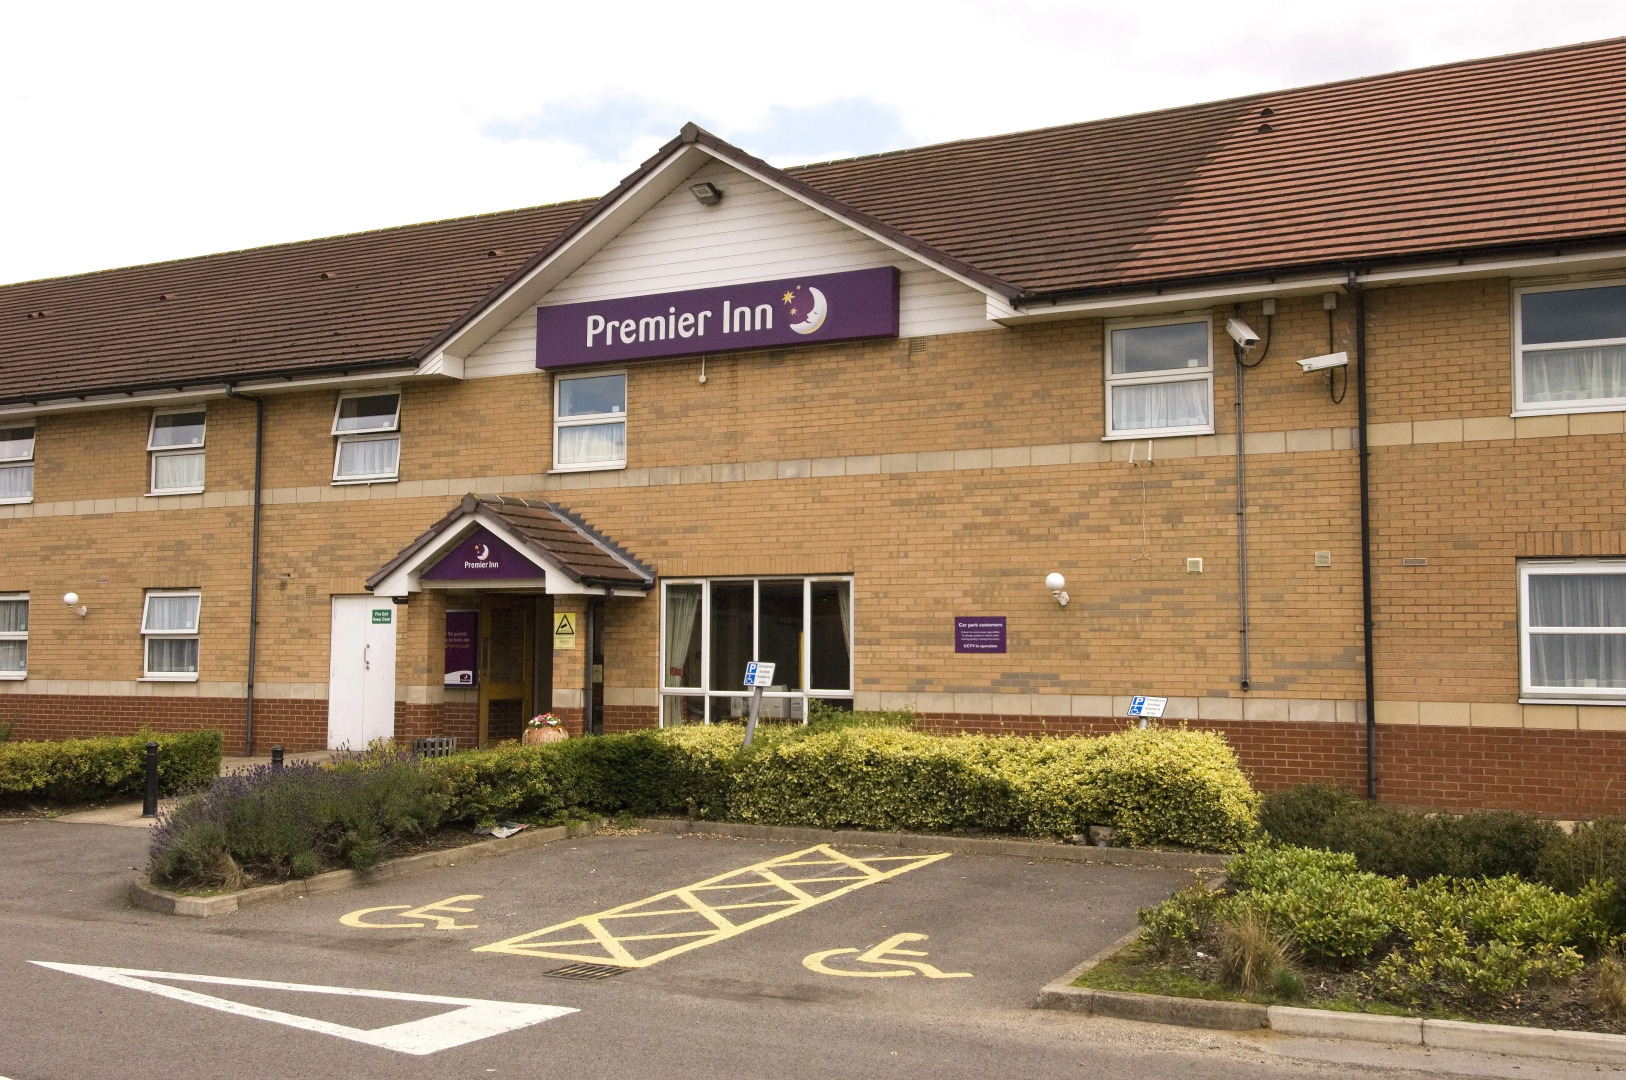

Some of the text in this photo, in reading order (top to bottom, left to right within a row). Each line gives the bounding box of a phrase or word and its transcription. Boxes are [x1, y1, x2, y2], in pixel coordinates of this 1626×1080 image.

[586, 300, 773, 347] Premier Inn
[464, 560, 499, 569] Premier Inn
[749, 663, 757, 673] P
[1135, 697, 1144, 705] P
